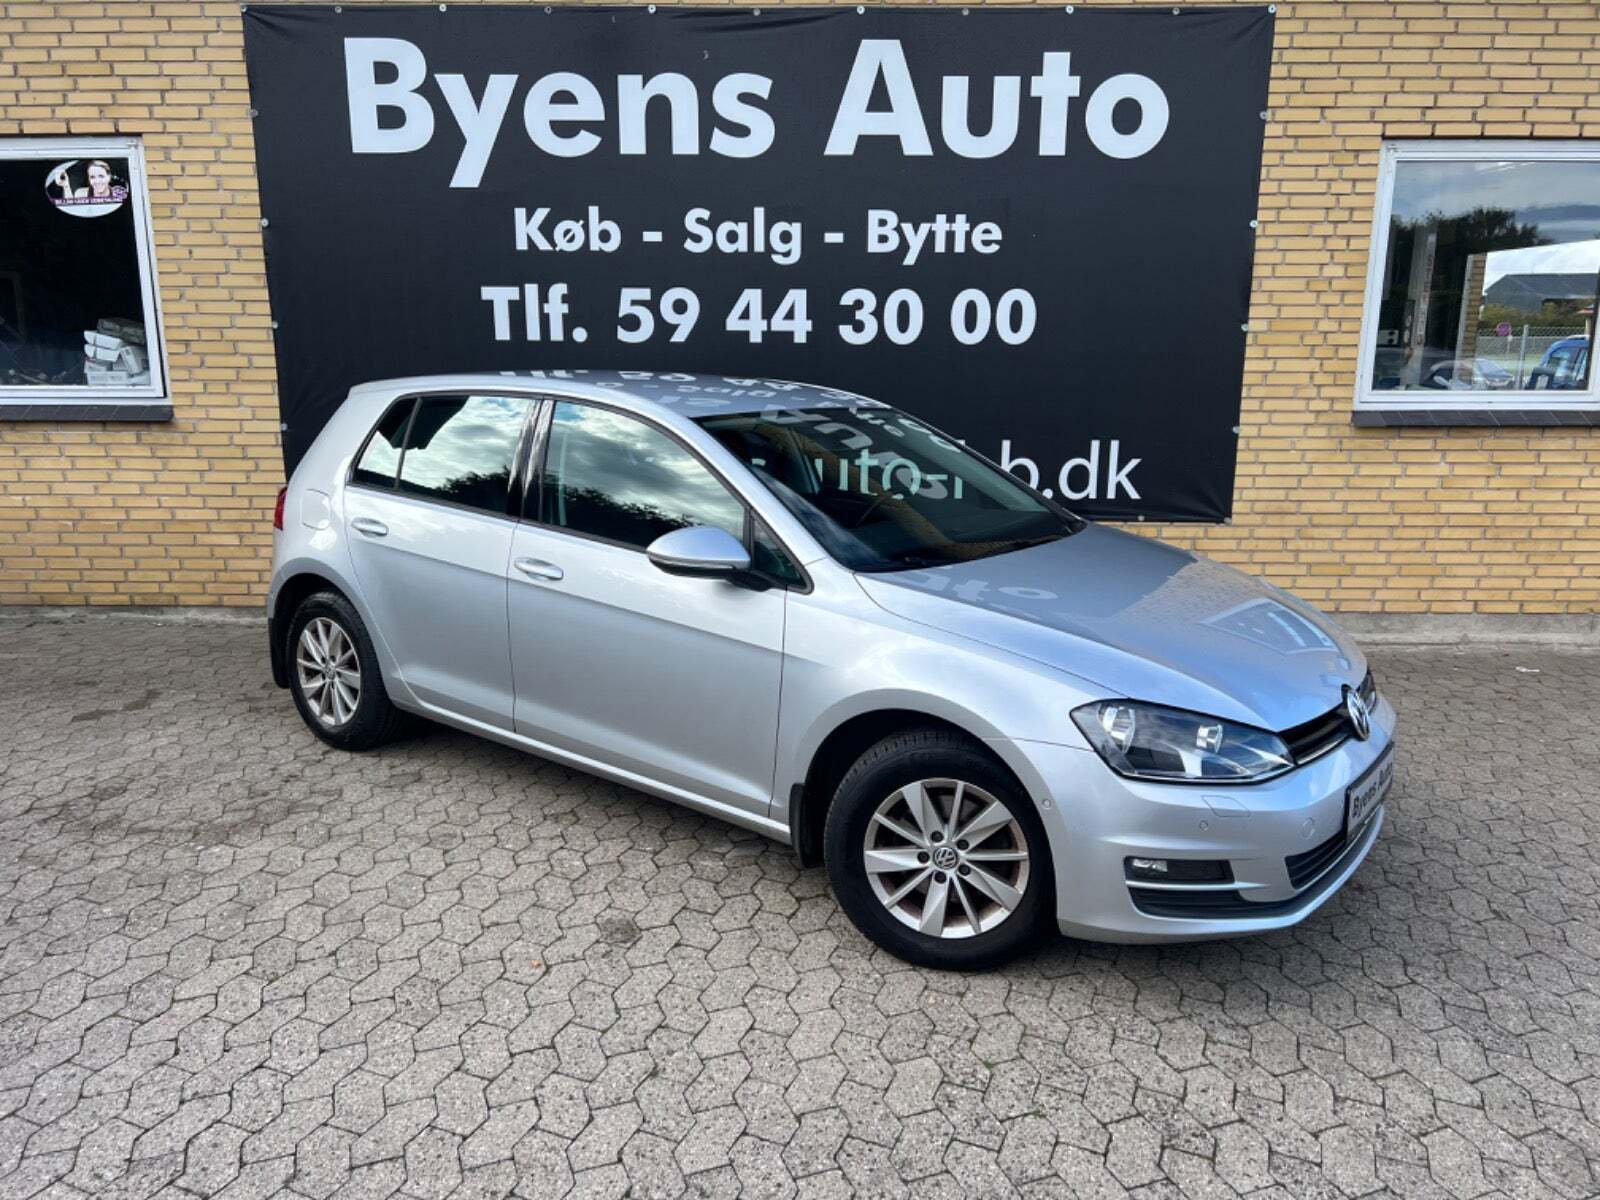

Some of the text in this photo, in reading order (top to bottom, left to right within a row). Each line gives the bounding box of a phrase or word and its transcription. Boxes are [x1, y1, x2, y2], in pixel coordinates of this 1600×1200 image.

[344, 37, 1170, 188] Byens Auto
[514, 206, 622, 253] Køb
[684, 207, 801, 265] Salg
[868, 210, 1003, 265] Bytte
[481, 283, 1036, 344] Tlf. 59 44 30 00
